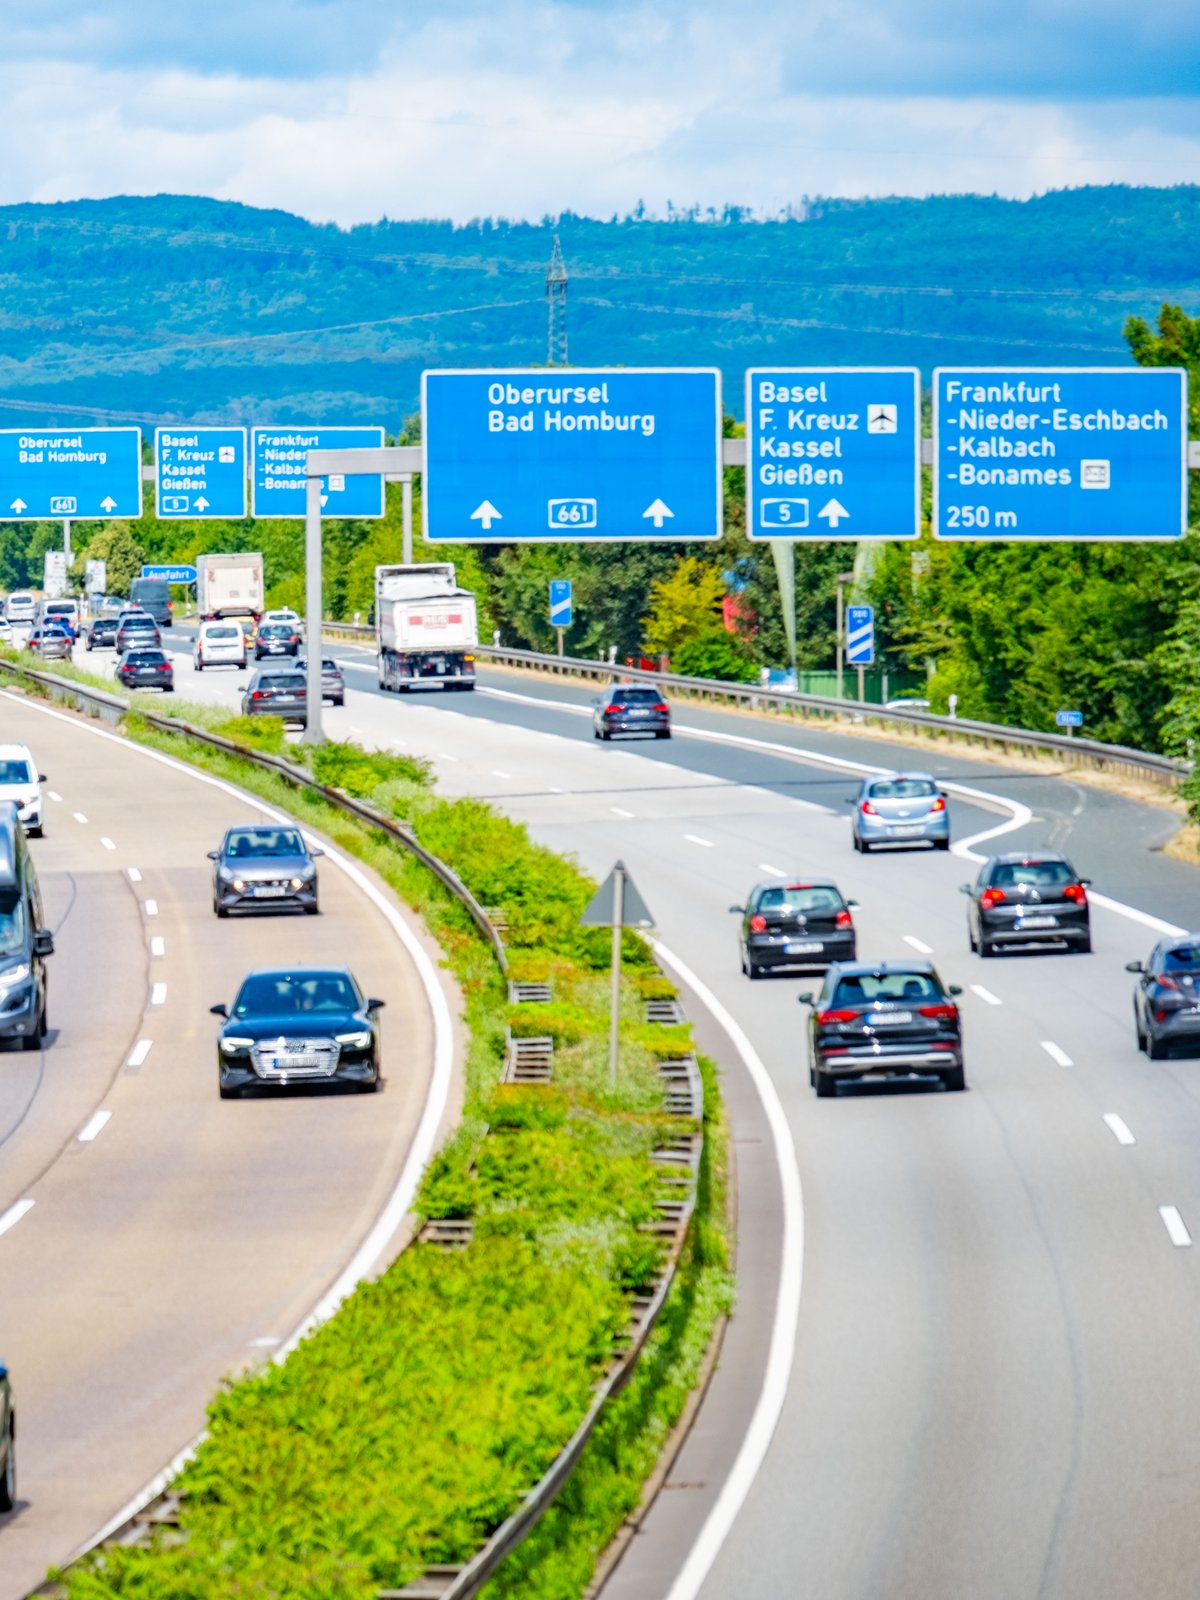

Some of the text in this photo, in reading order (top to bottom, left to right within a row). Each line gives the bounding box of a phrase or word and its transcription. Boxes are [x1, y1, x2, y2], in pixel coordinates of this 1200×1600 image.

[488, 382, 609, 405] Oberursel
[759, 381, 828, 403] Basel
[946, 380, 1061, 403] Frankfurt
[488, 410, 655, 437] Bad Homburg
[759, 408, 860, 431] F. Kreuz
[947, 408, 1168, 431] -Nieder-Eschbach
[19, 435, 83, 449] Oberursel
[161, 434, 199, 447] Basel
[258, 434, 319, 447] Frankfurt
[759, 436, 842, 458] Kassel
[947, 436, 1056, 459] -Kalbach
[19, 450, 107, 465] Bad Homburg
[177, 449, 215, 461] Kreuz
[161, 463, 206, 476] Kassel
[759, 463, 843, 486] Gießen
[947, 463, 1072, 486] -Bonames
[161, 477, 207, 490] Gießen
[54, 499, 73, 510] 661
[557, 504, 588, 523] 661
[779, 503, 791, 522] 5
[946, 505, 1018, 528] 250 m
[149, 569, 190, 580] Ausfahrt
